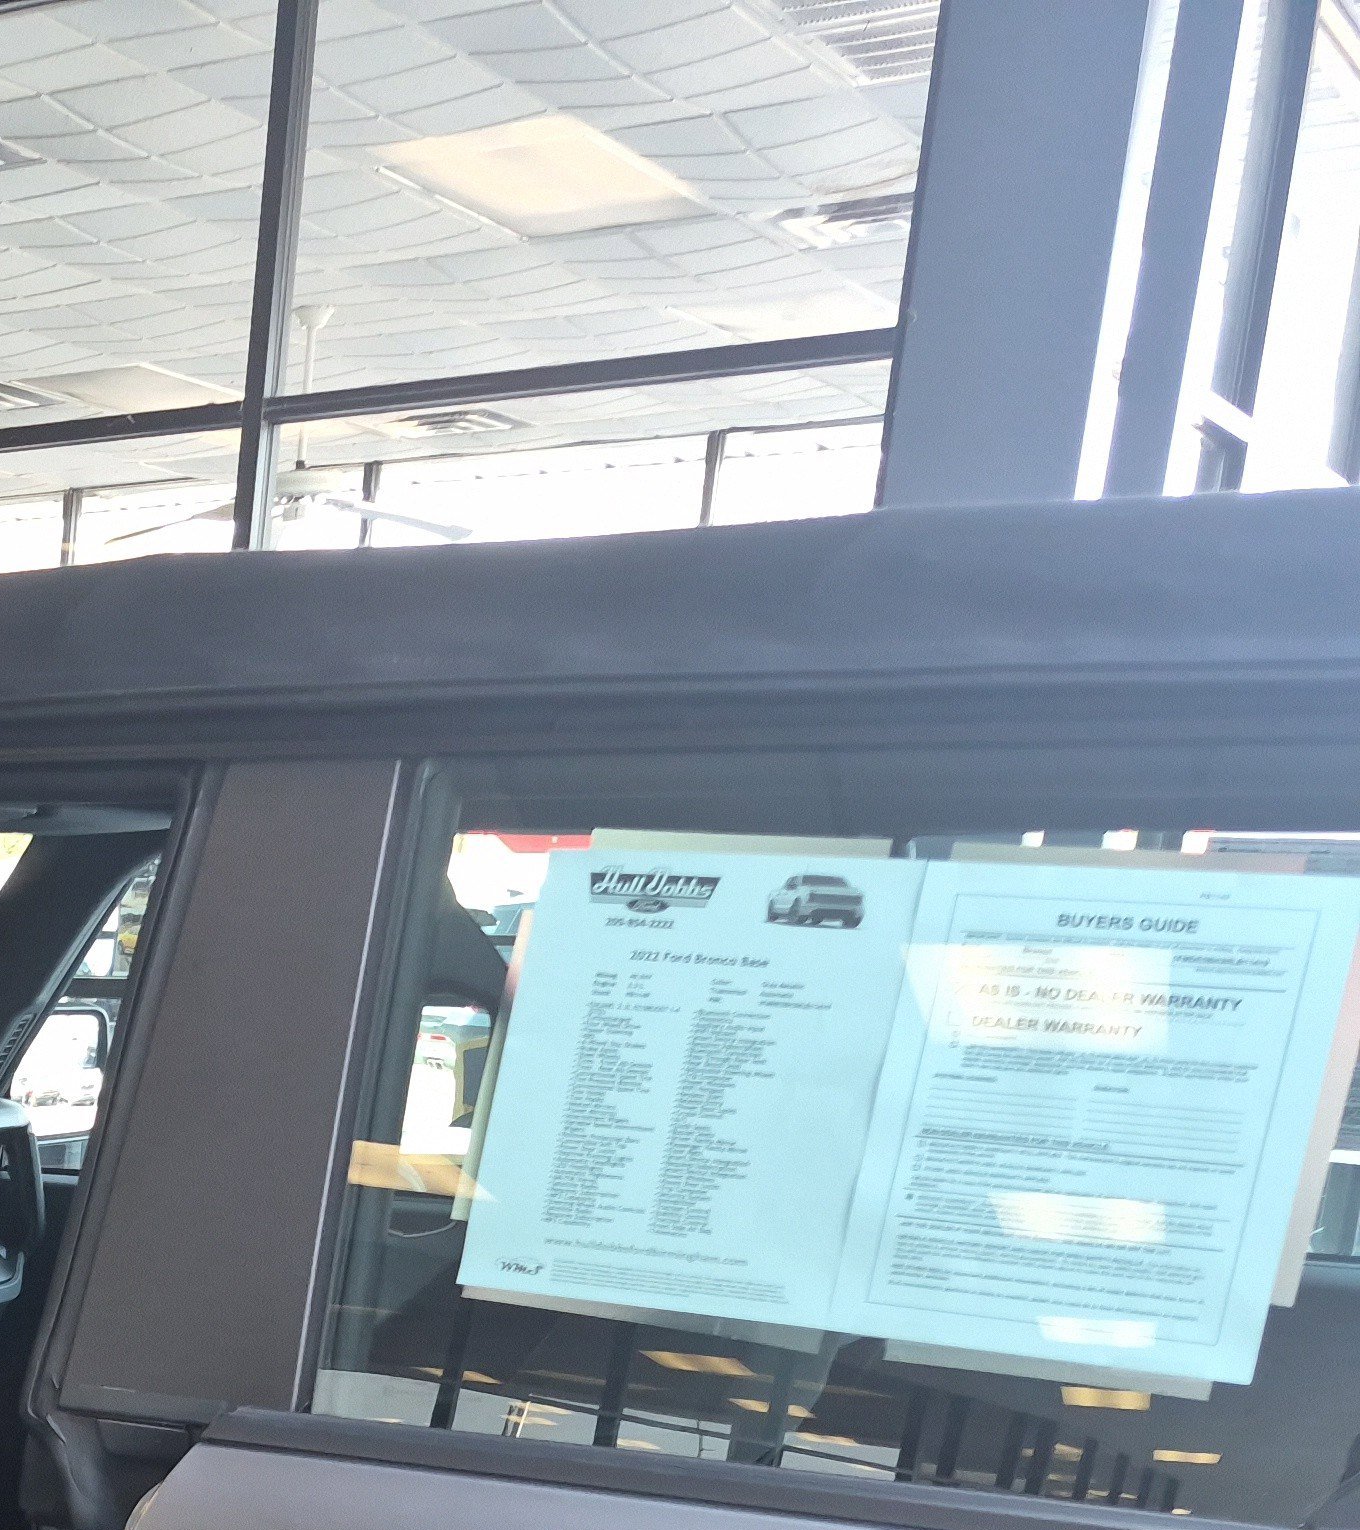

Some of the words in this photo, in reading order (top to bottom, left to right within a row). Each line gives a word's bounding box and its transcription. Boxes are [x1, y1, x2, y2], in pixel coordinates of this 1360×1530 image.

[592, 865, 647, 894] Hull
[646, 866, 714, 897] Dobbs
[1057, 913, 1134, 931] BUYERS
[1139, 915, 1199, 933] GUIDE
[630, 950, 660, 962] 2022
[662, 950, 691, 964] Ford
[694, 953, 738, 966] Bronco
[740, 956, 770, 967] Base
[979, 984, 1000, 998] AS
[1005, 985, 1021, 998] IS
[1034, 985, 1060, 1001] NO
[1064, 986, 1134, 1006] DEAER
[1139, 991, 1243, 1012] WARRANTY
[972, 1014, 1040, 1031] DEALER
[1043, 1017, 1143, 1038] WARRANTY
